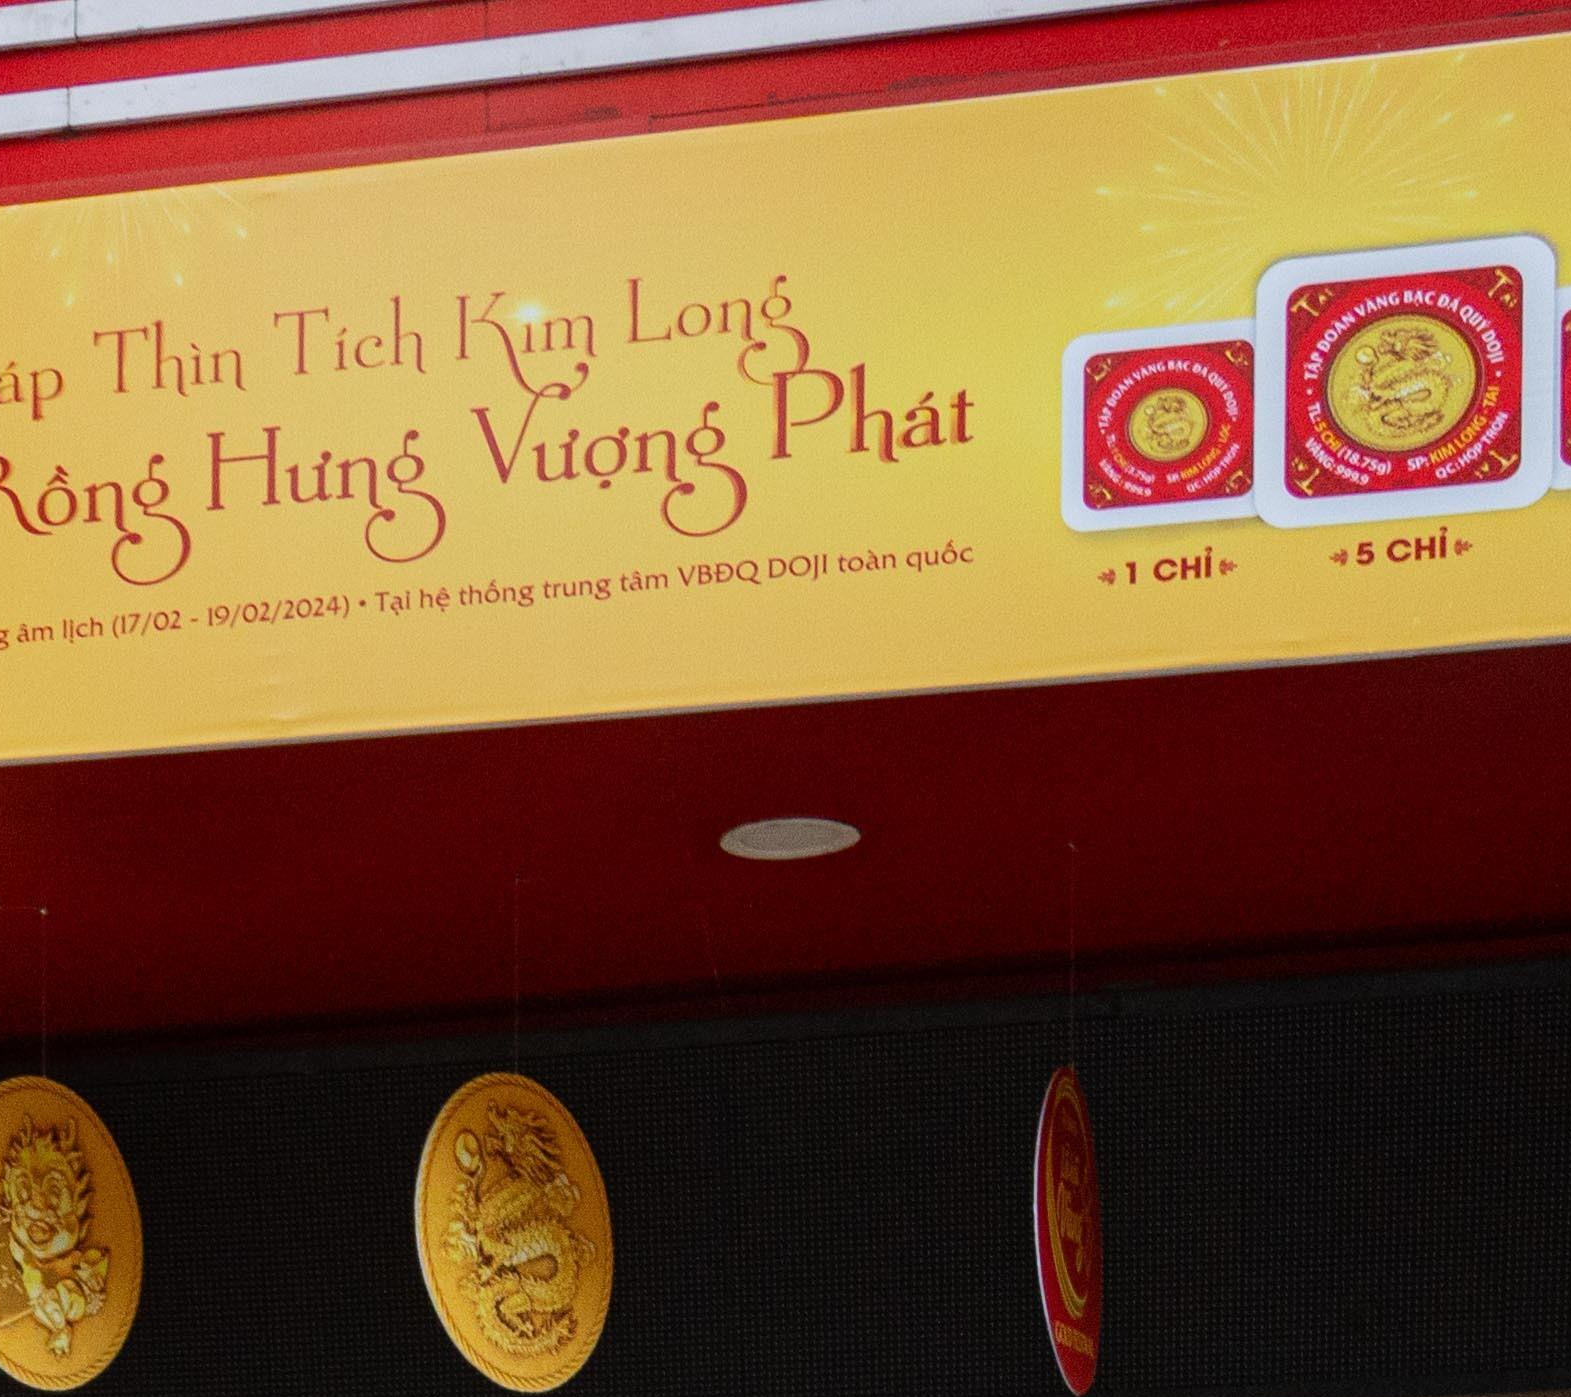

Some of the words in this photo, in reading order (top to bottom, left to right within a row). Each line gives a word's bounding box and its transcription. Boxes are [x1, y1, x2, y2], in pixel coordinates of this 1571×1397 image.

[92, 320, 247, 400] Thìn
[273, 295, 429, 377] Tích
[456, 288, 598, 398] Kim
[624, 273, 813, 388] Long
[206, 424, 448, 565] Hưng
[470, 392, 749, 539] Vượng
[770, 362, 976, 465] Phát
[17, 619, 55, 644] âm
[61, 616, 104, 644] lịch
[112, 608, 183, 641] (17/02
[206, 592, 350, 629] 19/02/2024)
[376, 590, 412, 616] Tại
[418, 585, 451, 612] hệ
[458, 577, 535, 609] thống
[543, 576, 613, 605] trung
[619, 569, 670, 594] tâm
[677, 559, 762, 591] VBĐQ
[768, 553, 830, 581] DOJI
[837, 548, 897, 574] toàn
[905, 537, 975, 573] quốc
[1124, 560, 1139, 585] 1
[1153, 546, 1215, 584] CHỈ
[1355, 540, 1376, 566] 5
[1387, 526, 1449, 563] CHỈ
